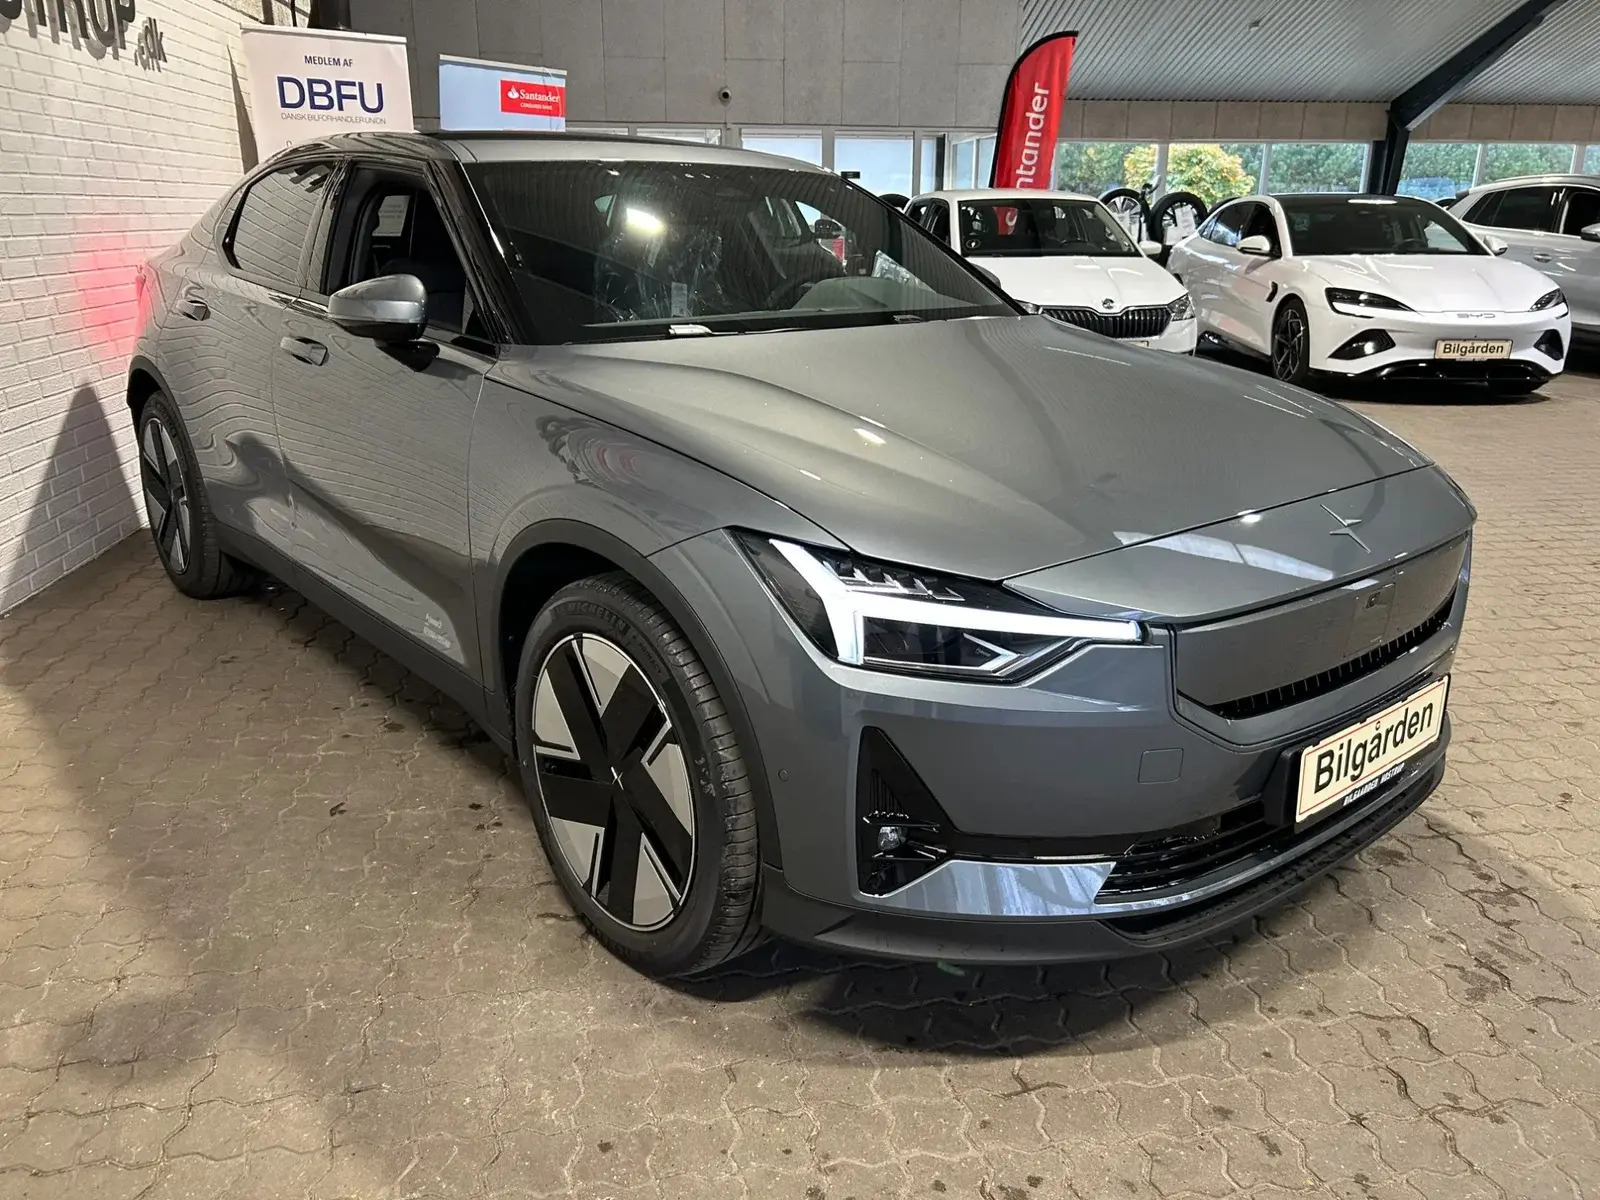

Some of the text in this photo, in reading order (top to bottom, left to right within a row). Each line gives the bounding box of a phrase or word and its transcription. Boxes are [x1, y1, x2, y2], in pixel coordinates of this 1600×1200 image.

[304, 55, 353, 67] MEDLEM AF
[277, 75, 384, 113] DBFU
[519, 89, 560, 103] Santander
[280, 112, 307, 121] DANSK
[365, 117, 386, 125] UNION
[1015, 82, 1049, 189] ntander
[1442, 341, 1504, 357] Bilgården
[1314, 702, 1434, 794] Bilgården
